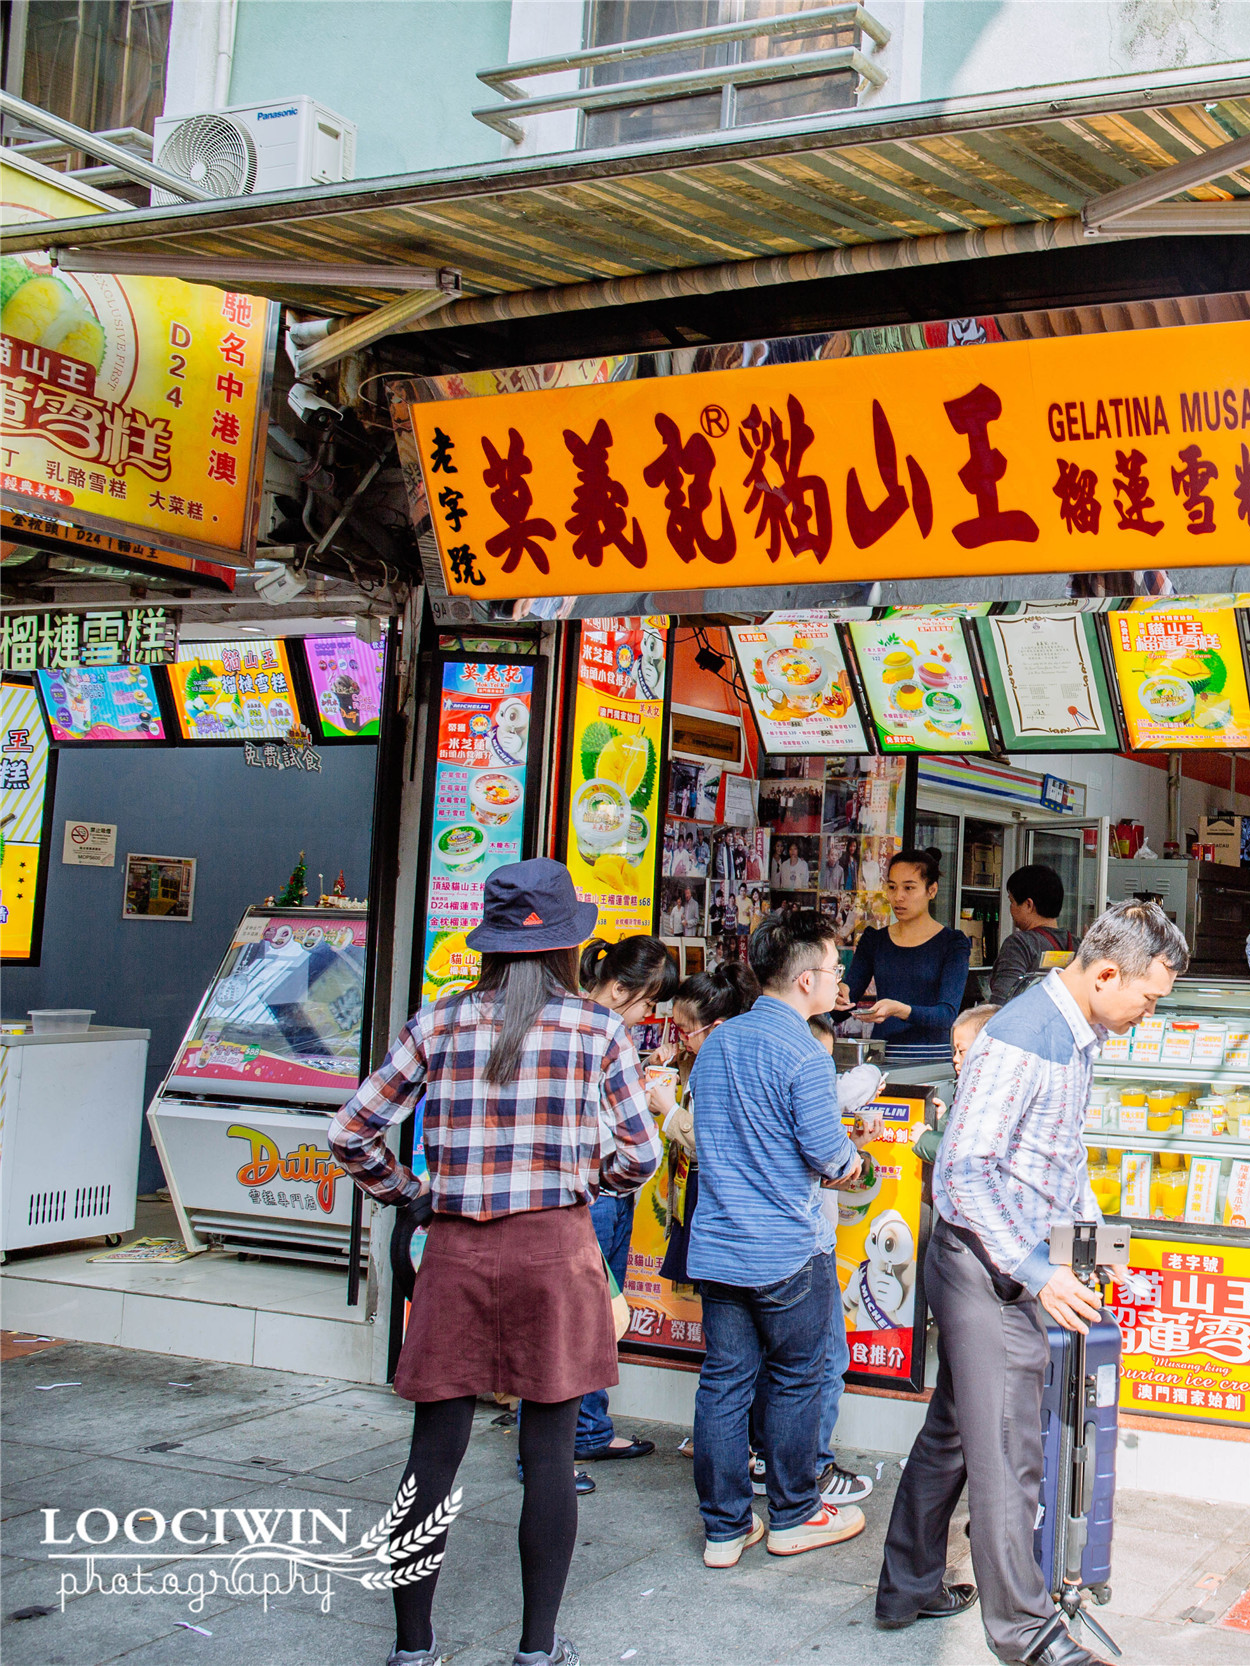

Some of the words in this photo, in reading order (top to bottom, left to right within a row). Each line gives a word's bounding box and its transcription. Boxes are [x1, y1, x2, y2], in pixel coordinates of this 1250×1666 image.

[257, 107, 298, 121] Panasonic
[106, 352, 127, 392] FIRST
[207, 291, 252, 486] 馳名中港澳
[1048, 395, 1170, 442] GELATINA
[4, 476, 64, 502] 經典美味
[45, 459, 127, 500] 乳酪雪糕
[149, 490, 204, 521] 大菜糕
[430, 427, 486, 586] 老字號
[0, 607, 167, 670] 榴槤雪糕
[1147, 622, 1203, 635] 貓山王
[1135, 634, 1221, 652] 榴蓮雪糕
[221, 648, 279, 671] 貓山王
[221, 672, 289, 694] 榴槤雪糕
[452, 702, 490, 711] MICHELIN
[448, 738, 486, 750] 米芝蓮
[244, 741, 322, 773] 免費試食
[639, 897, 651, 907] $68
[226, 1124, 347, 1214] Dutty
[1168, 1253, 1219, 1273] 老字號
[1152, 1357, 1203, 1374] Musang
[1203, 1361, 1232, 1377] king
[1185, 1371, 1216, 1388] ice
[1137, 1383, 1242, 1411] 澳門獨家始創
